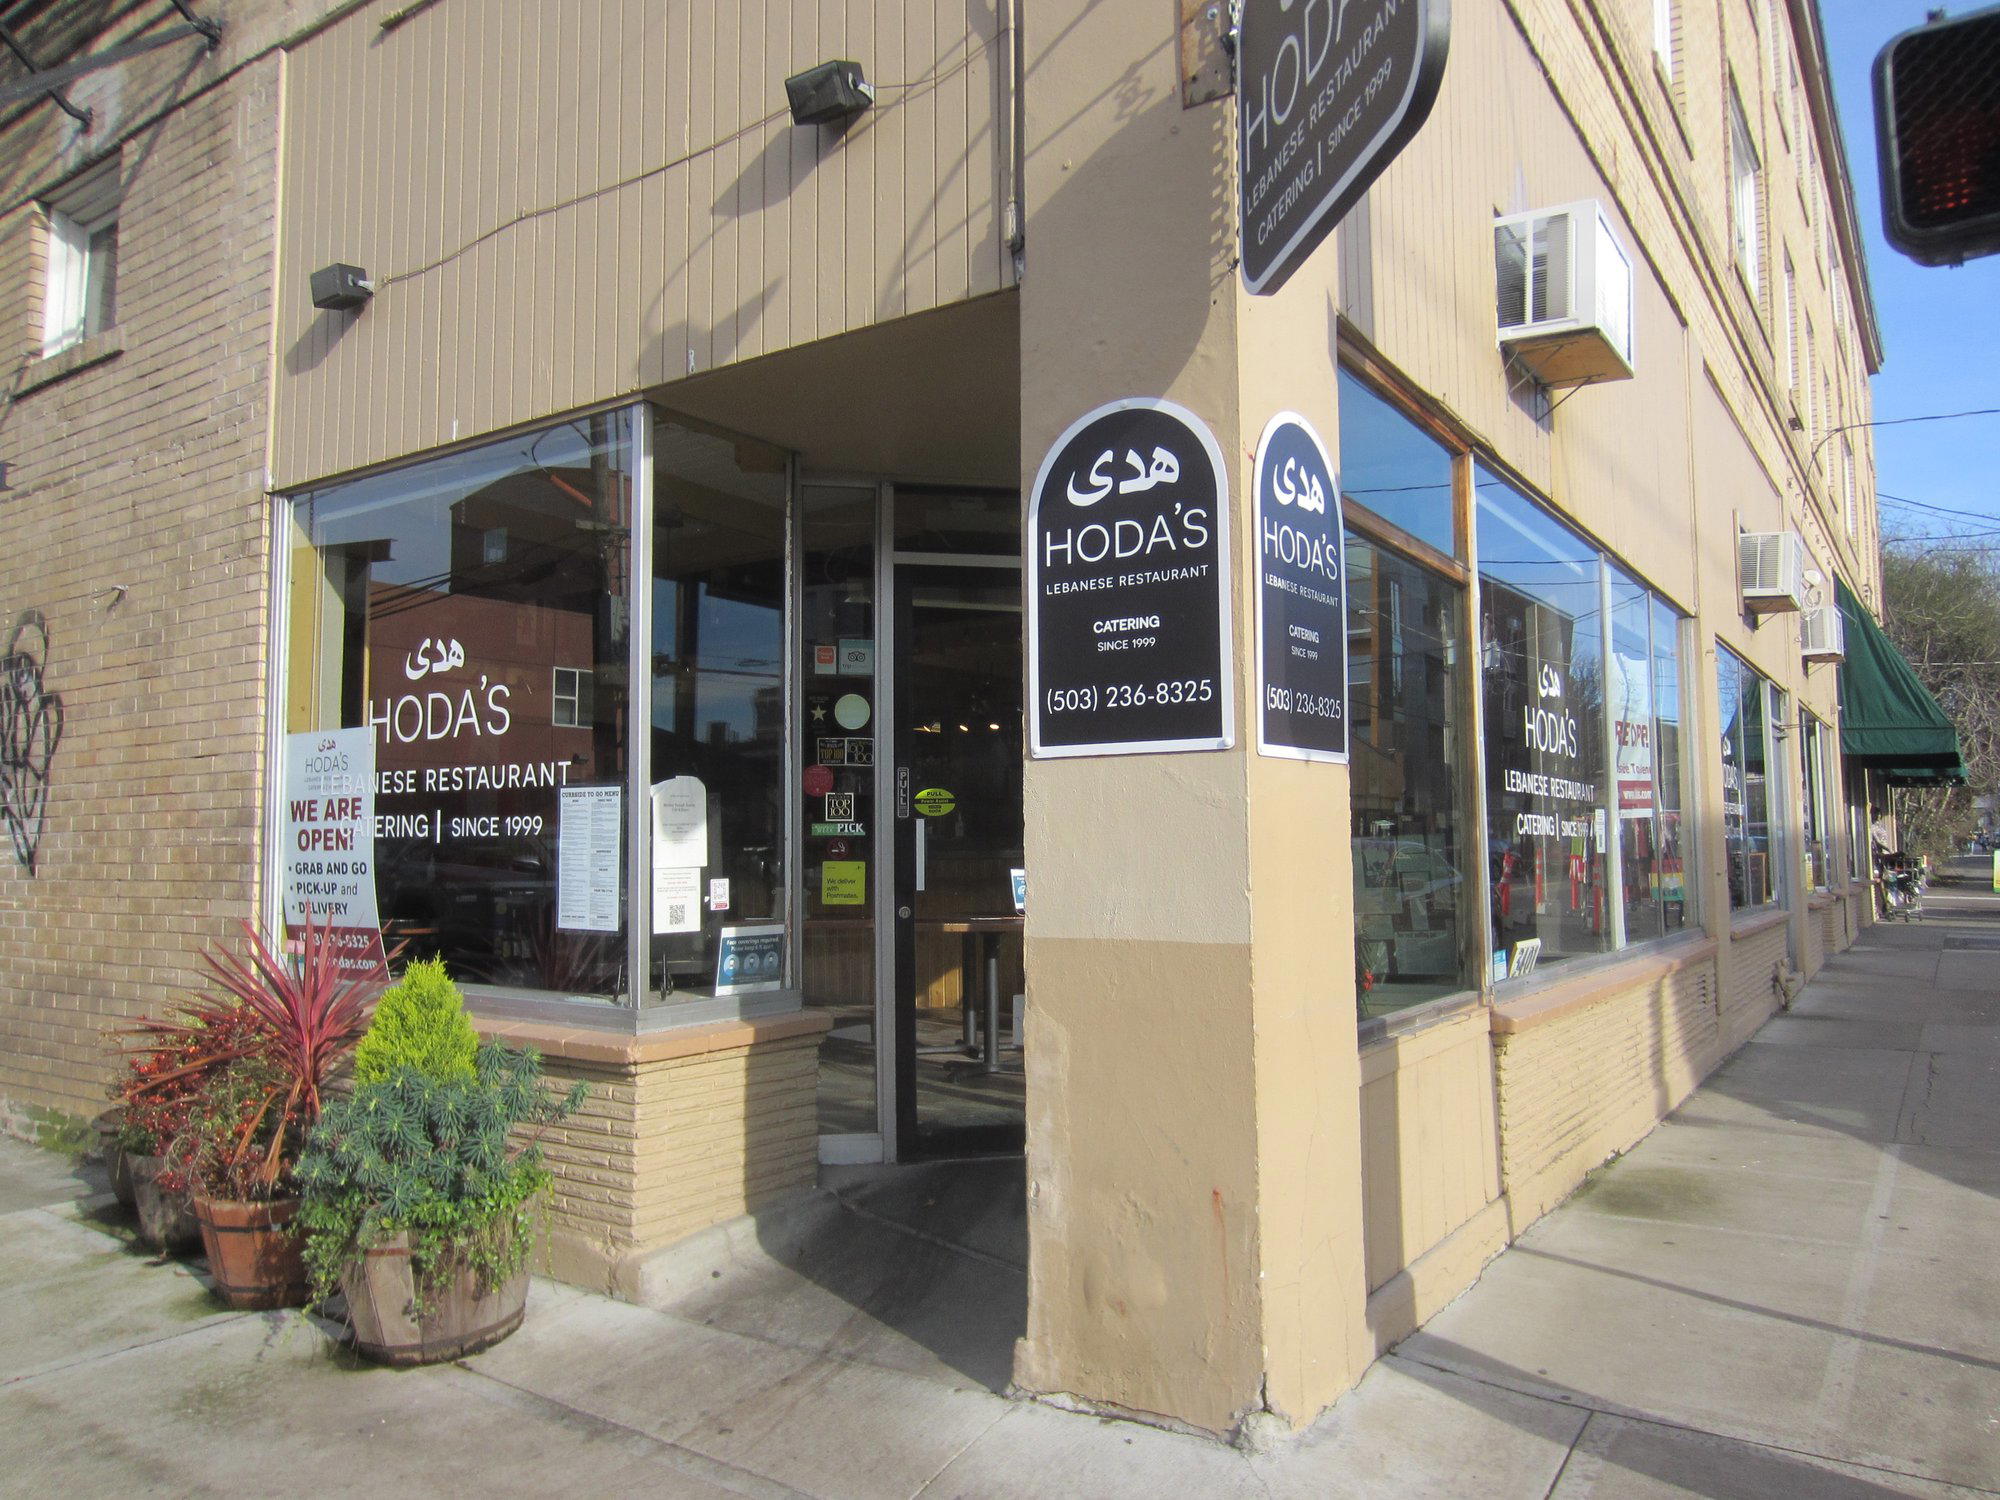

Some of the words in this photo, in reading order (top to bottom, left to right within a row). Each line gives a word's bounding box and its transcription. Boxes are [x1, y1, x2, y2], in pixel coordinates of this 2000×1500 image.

[1246, 120, 1305, 216] LEBANESE
[1309, 0, 1404, 130] RESTAURAN
[1257, 160, 1314, 246] CATERING
[1328, 95, 1362, 154] SINCE
[1364, 57, 1392, 106] 1999
[1045, 502, 1209, 568] HODA'S
[1264, 516, 1338, 580] HODA'S
[1046, 577, 1114, 595] LEBANESE
[1119, 565, 1209, 586] RESTAURANT
[1265, 572, 1298, 595] LEBANESE
[1299, 585, 1339, 608] RESTAURANT
[1093, 615, 1160, 634] CATERING
[1288, 624, 1320, 644] CATERING
[1097, 639, 1129, 652] SINCE
[1132, 637, 1156, 649] 1999
[1291, 645, 1306, 659] SINCE
[1307, 648, 1318, 660] 1999
[1047, 686, 1098, 714] (503)
[1106, 680, 1212, 709] 236-8325
[1267, 683, 1293, 713] (503)
[1296, 692, 1341, 719] 236-8325
[368, 675, 511, 746] HODA'S
[1524, 704, 1577, 758] HODA'S
[305, 752, 349, 773] HODA'S
[425, 761, 572, 792] RESTAURANT
[899, 771, 907, 805] PULL
[1504, 769, 1549, 797] LEBANESE
[1550, 777, 1594, 803] RESTAURANT
[291, 799, 318, 822] WE
[324, 797, 362, 821] ARE
[829, 799, 851, 808] TOP
[830, 807, 850, 817] 100
[451, 817, 500, 837] SINCE
[505, 815, 543, 836] 1999
[837, 823, 864, 833] PICK
[1516, 813, 1555, 836] CATERING
[1561, 820, 1577, 837] SINCE
[297, 828, 354, 852] OPEN!
[295, 862, 323, 875] GRAB
[327, 862, 348, 875] AND
[351, 862, 367, 875] GO
[297, 882, 338, 895] PICK-UP
[341, 883, 358, 896] and
